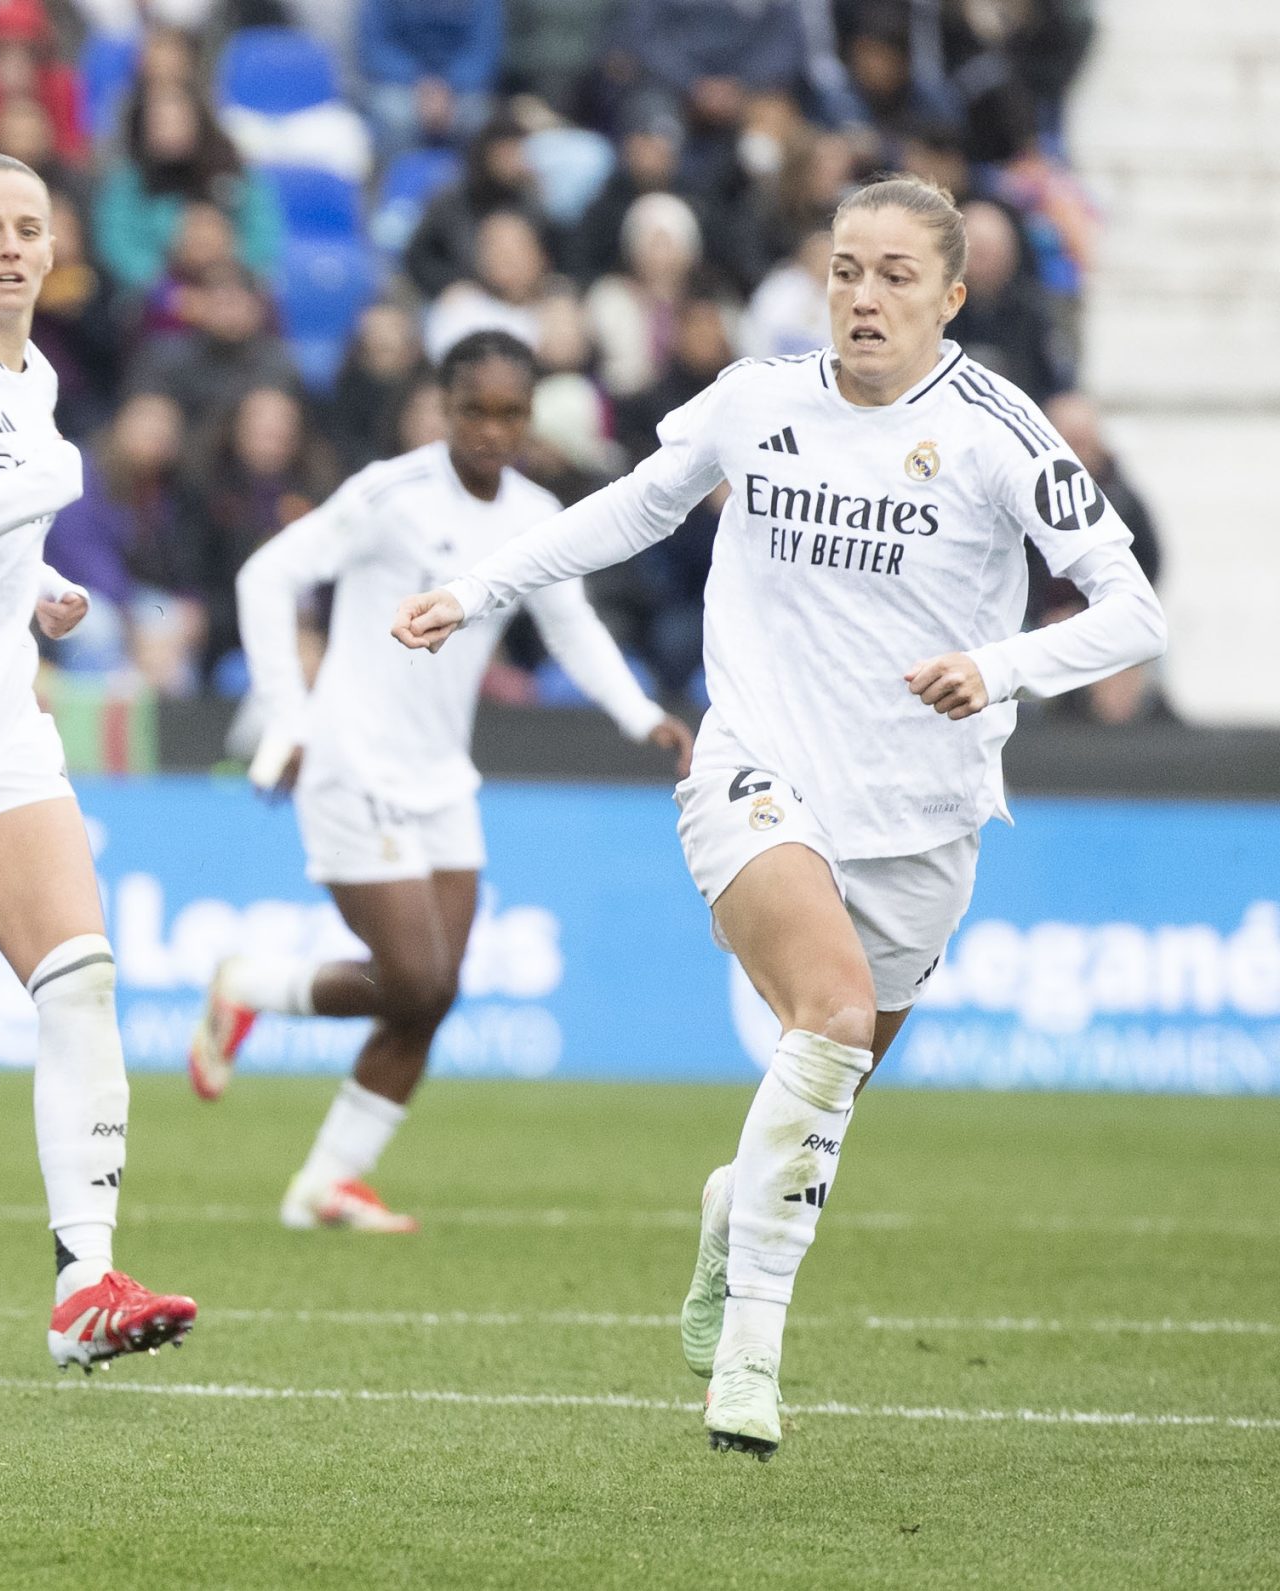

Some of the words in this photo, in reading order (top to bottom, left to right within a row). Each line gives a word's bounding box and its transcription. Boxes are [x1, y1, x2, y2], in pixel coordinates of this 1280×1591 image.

[746, 473, 939, 536] Emirates
[1045, 460, 1097, 530] hp
[771, 527, 804, 563] FLY
[811, 533, 905, 575] BETTER
[801, 1133, 841, 1156] RMC
